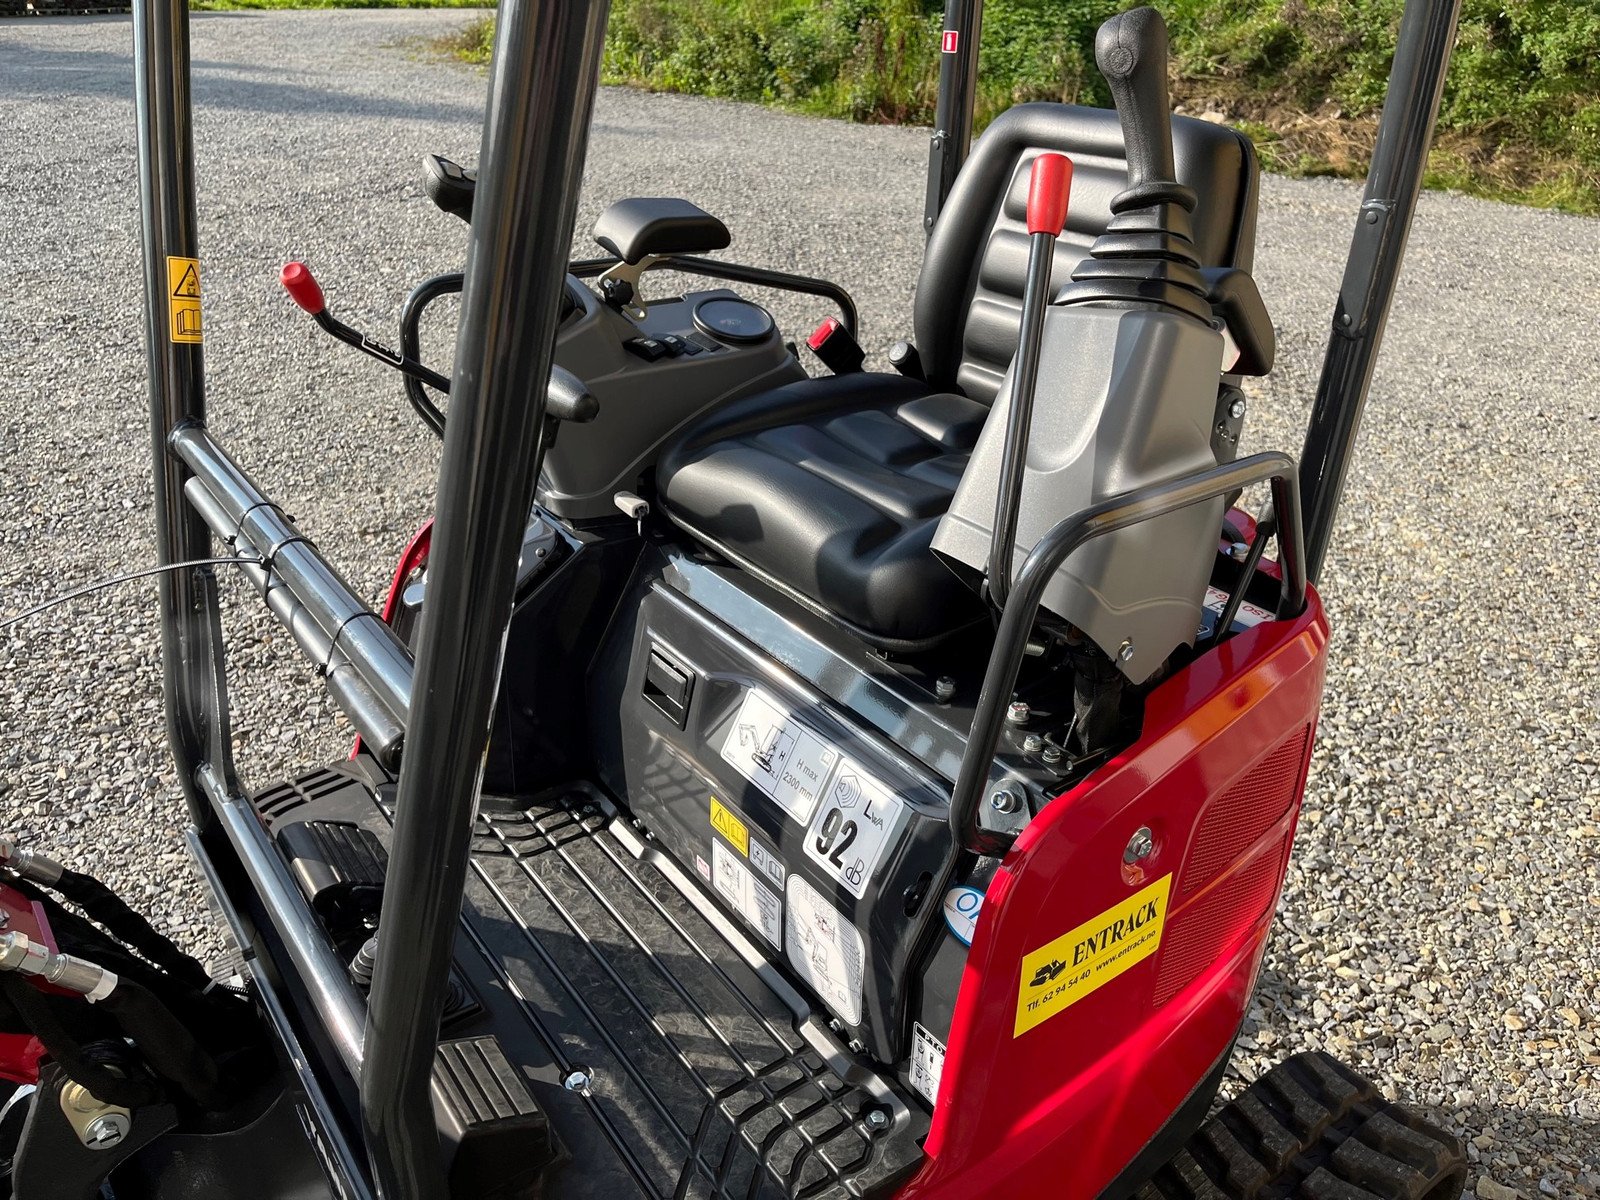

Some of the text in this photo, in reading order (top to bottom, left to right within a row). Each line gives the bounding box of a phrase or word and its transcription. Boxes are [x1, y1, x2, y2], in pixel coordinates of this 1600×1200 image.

[1242, 605, 1274, 620] ISO
[778, 752, 786, 762] H
[796, 758, 819, 782] H max
[783, 772, 813, 802] 2300 mm
[815, 807, 858, 870] 92
[845, 857, 865, 886] dB
[1072, 897, 1160, 968] ENTRACK
[1027, 999, 1041, 1012] Tlf.
[1042, 990, 1054, 1003] 62
[1055, 983, 1066, 996] 94
[1067, 976, 1079, 989] 54
[1079, 969, 1091, 981] 40
[1095, 930, 1156, 972] www.entrack.no
